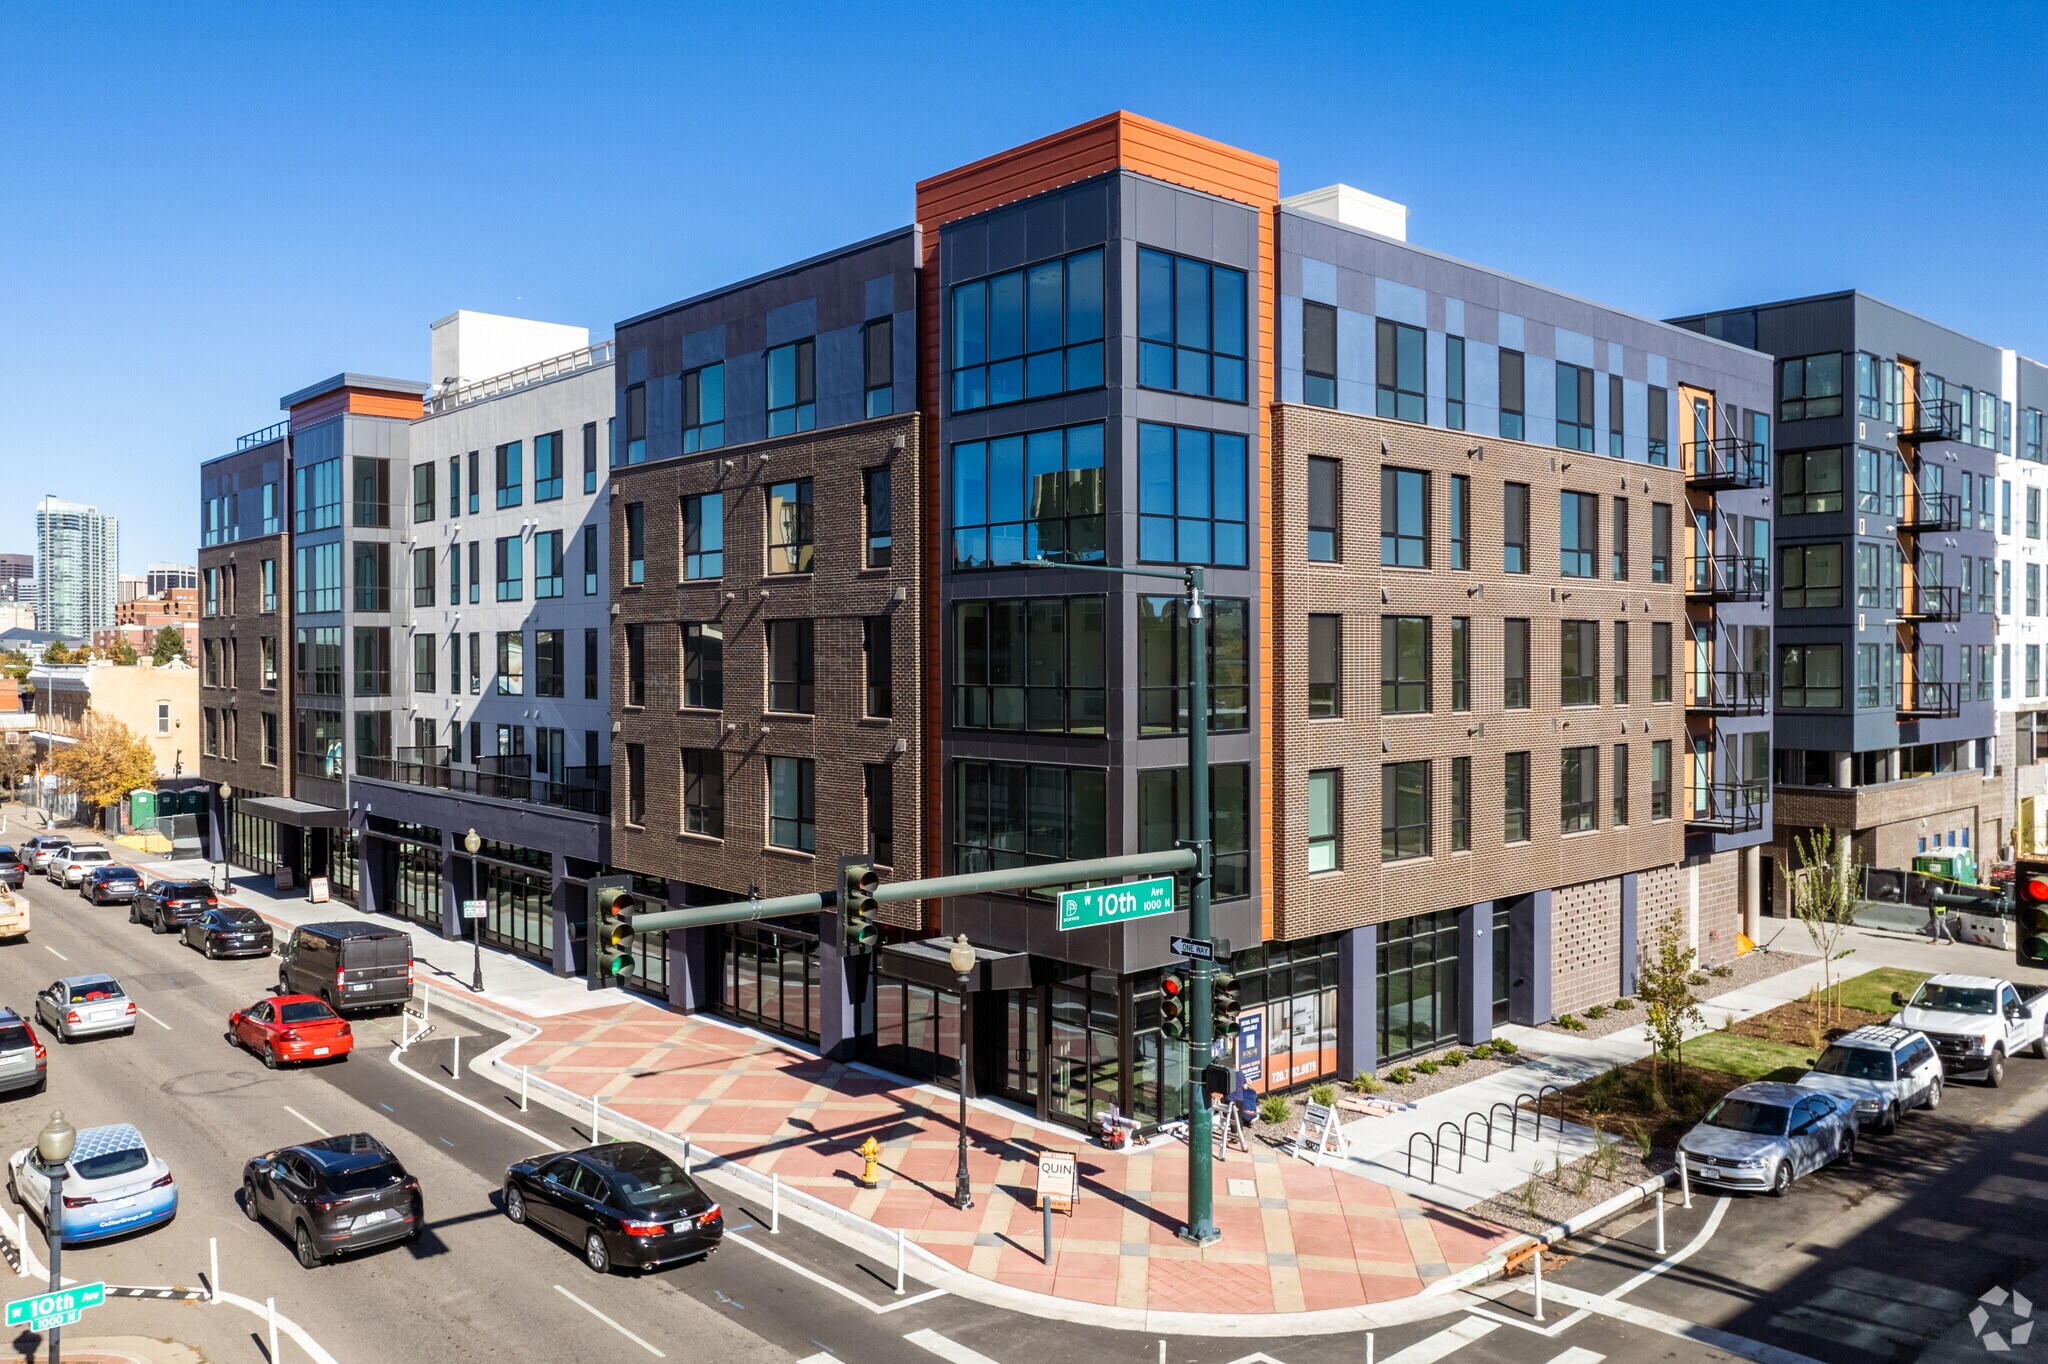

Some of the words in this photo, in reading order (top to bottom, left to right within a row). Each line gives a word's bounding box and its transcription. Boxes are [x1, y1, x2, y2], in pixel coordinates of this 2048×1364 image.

[1084, 895, 1091, 906] W
[1097, 891, 1136, 917] 10th
[1151, 888, 1163, 896] Ave
[1143, 899, 1161, 911] 1000
[1164, 898, 1170, 908] N
[1182, 943, 1194, 952] ONE
[1196, 946, 1209, 955] WAY
[1042, 1163, 1071, 1174] QUIN
[99, 1211, 152, 1228] CoStarGroup.com
[12, 1307, 21, 1318] W
[30, 1293, 74, 1317] 10th
[81, 1291, 99, 1302] Ave
[37, 1315, 63, 1329] 1000
[67, 1312, 75, 1322] N
